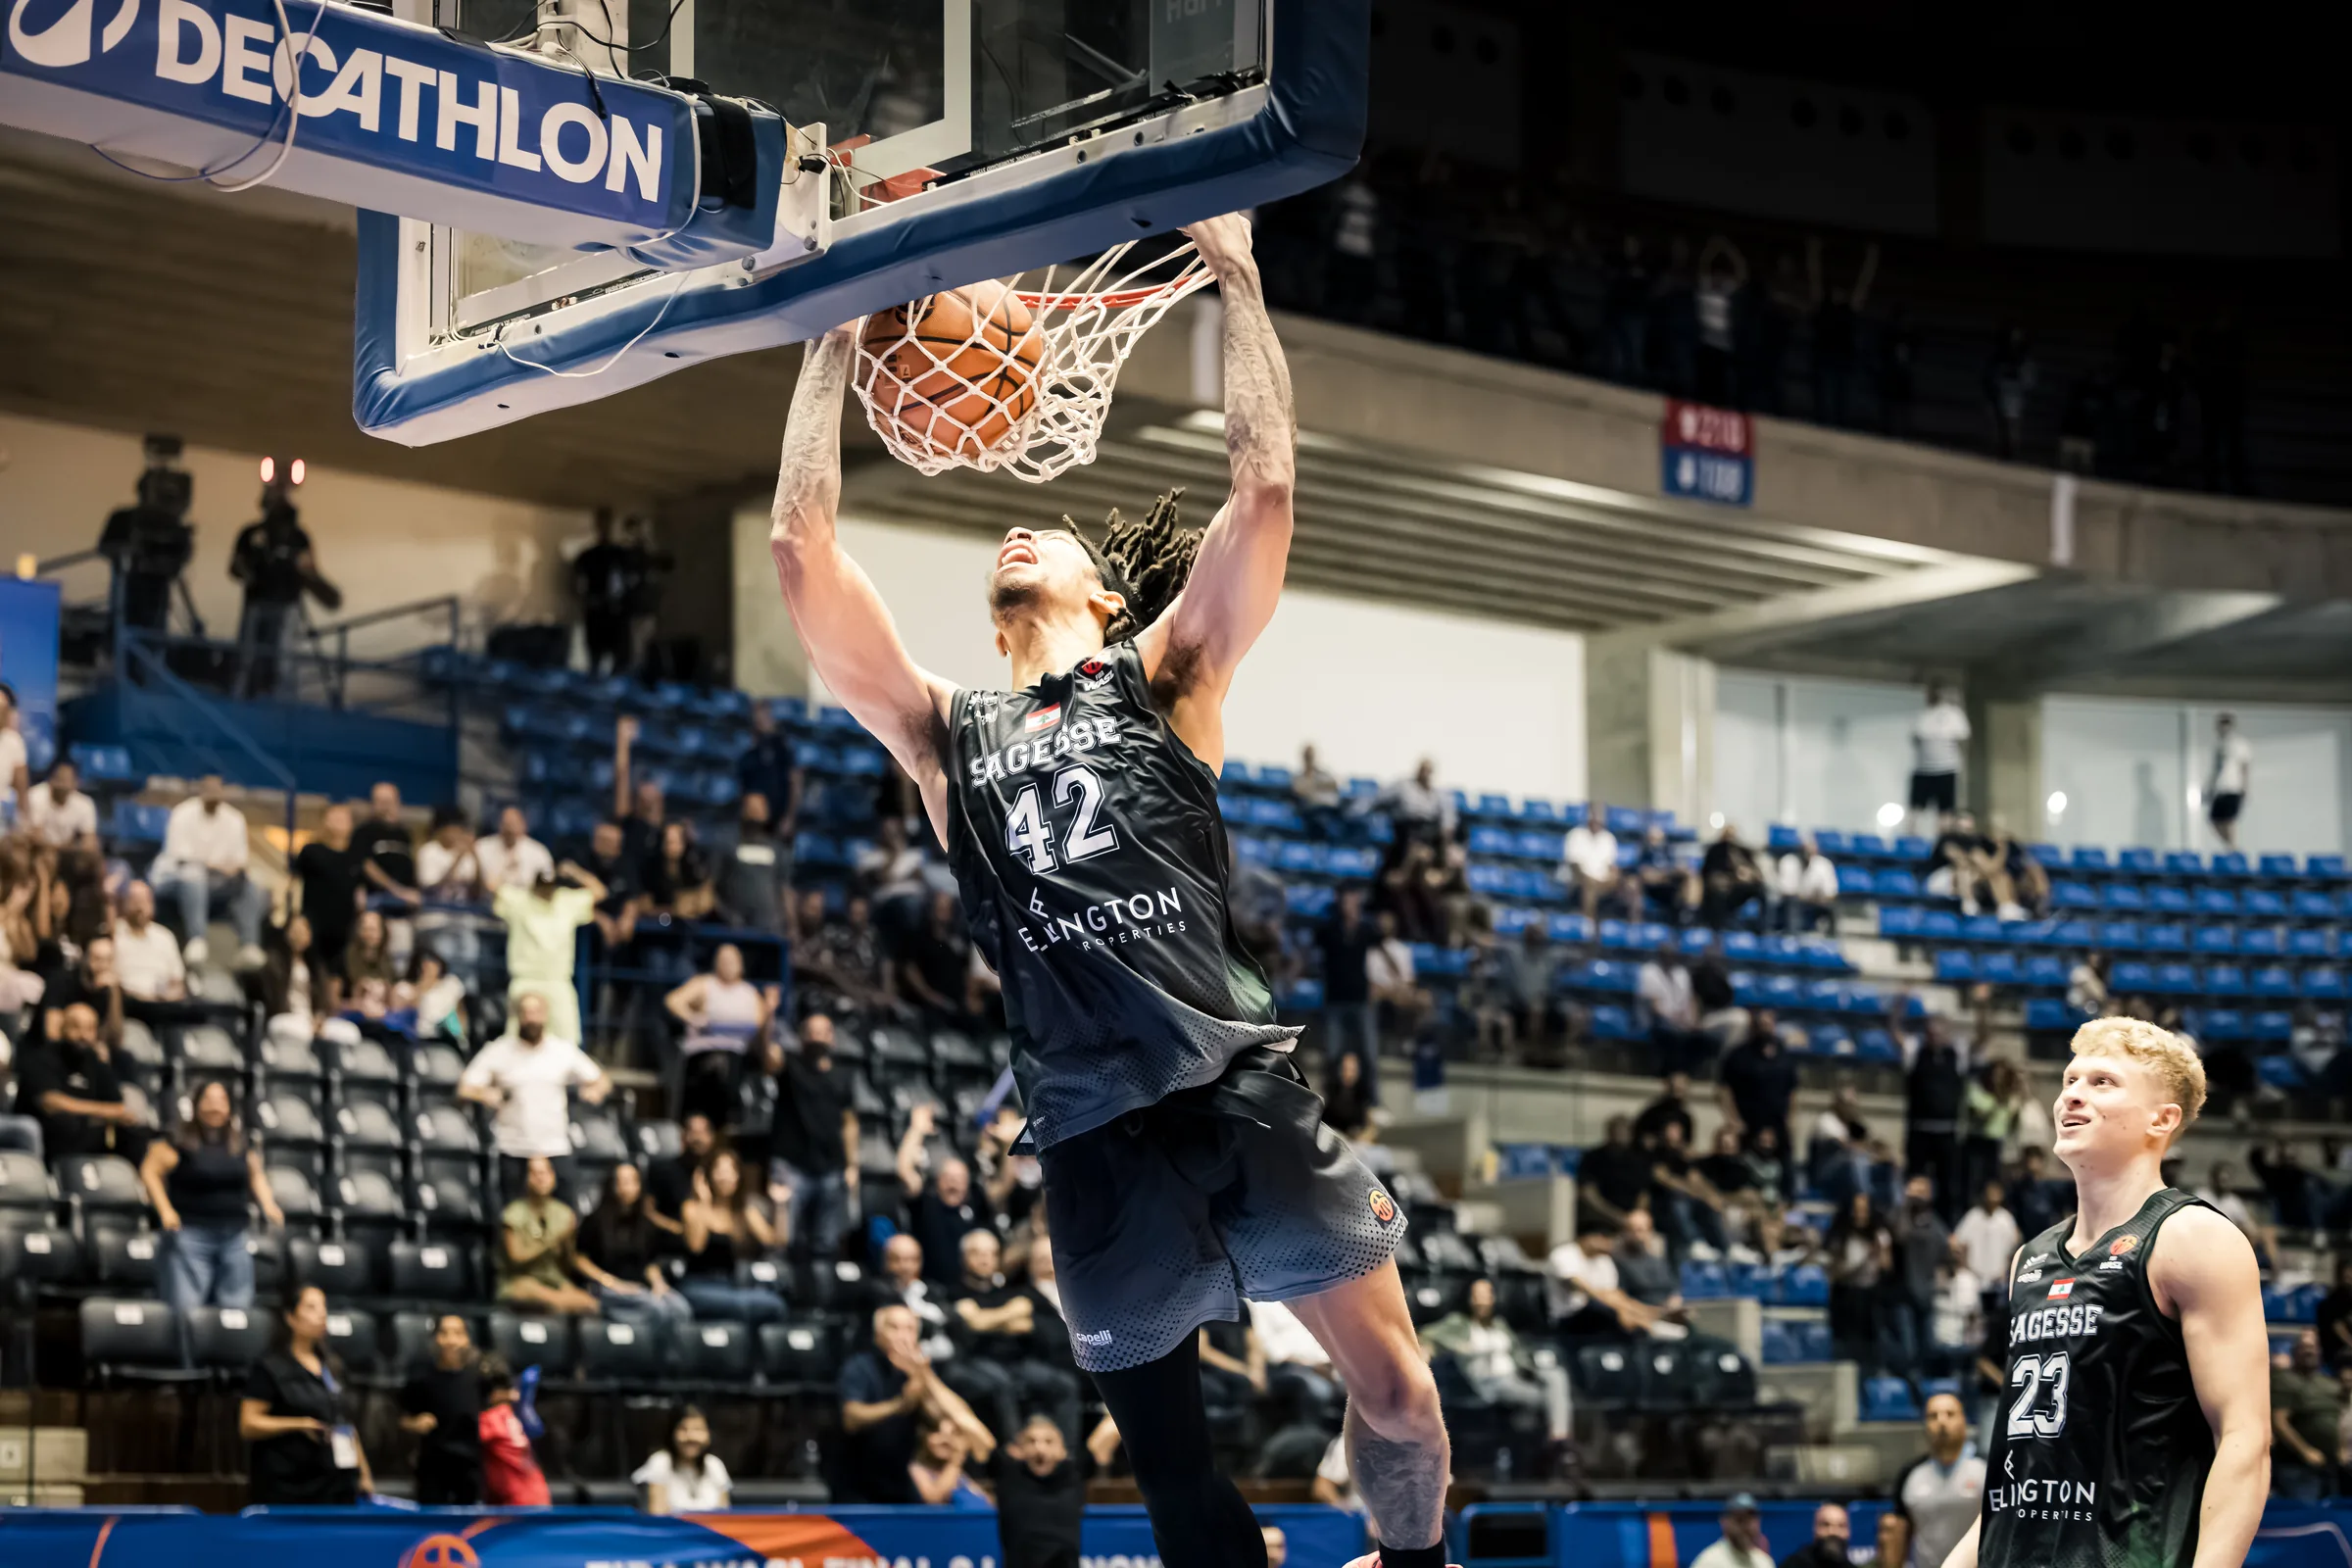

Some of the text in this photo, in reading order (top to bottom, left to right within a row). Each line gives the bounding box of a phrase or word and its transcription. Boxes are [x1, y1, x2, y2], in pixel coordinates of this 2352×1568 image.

[156, 0, 662, 203] DECATHLON
[969, 716, 1122, 788] SAGESSE
[1005, 761, 1120, 875] 42
[1076, 1329, 1112, 1346] capelli
[2007, 1350, 2071, 1441] 23
